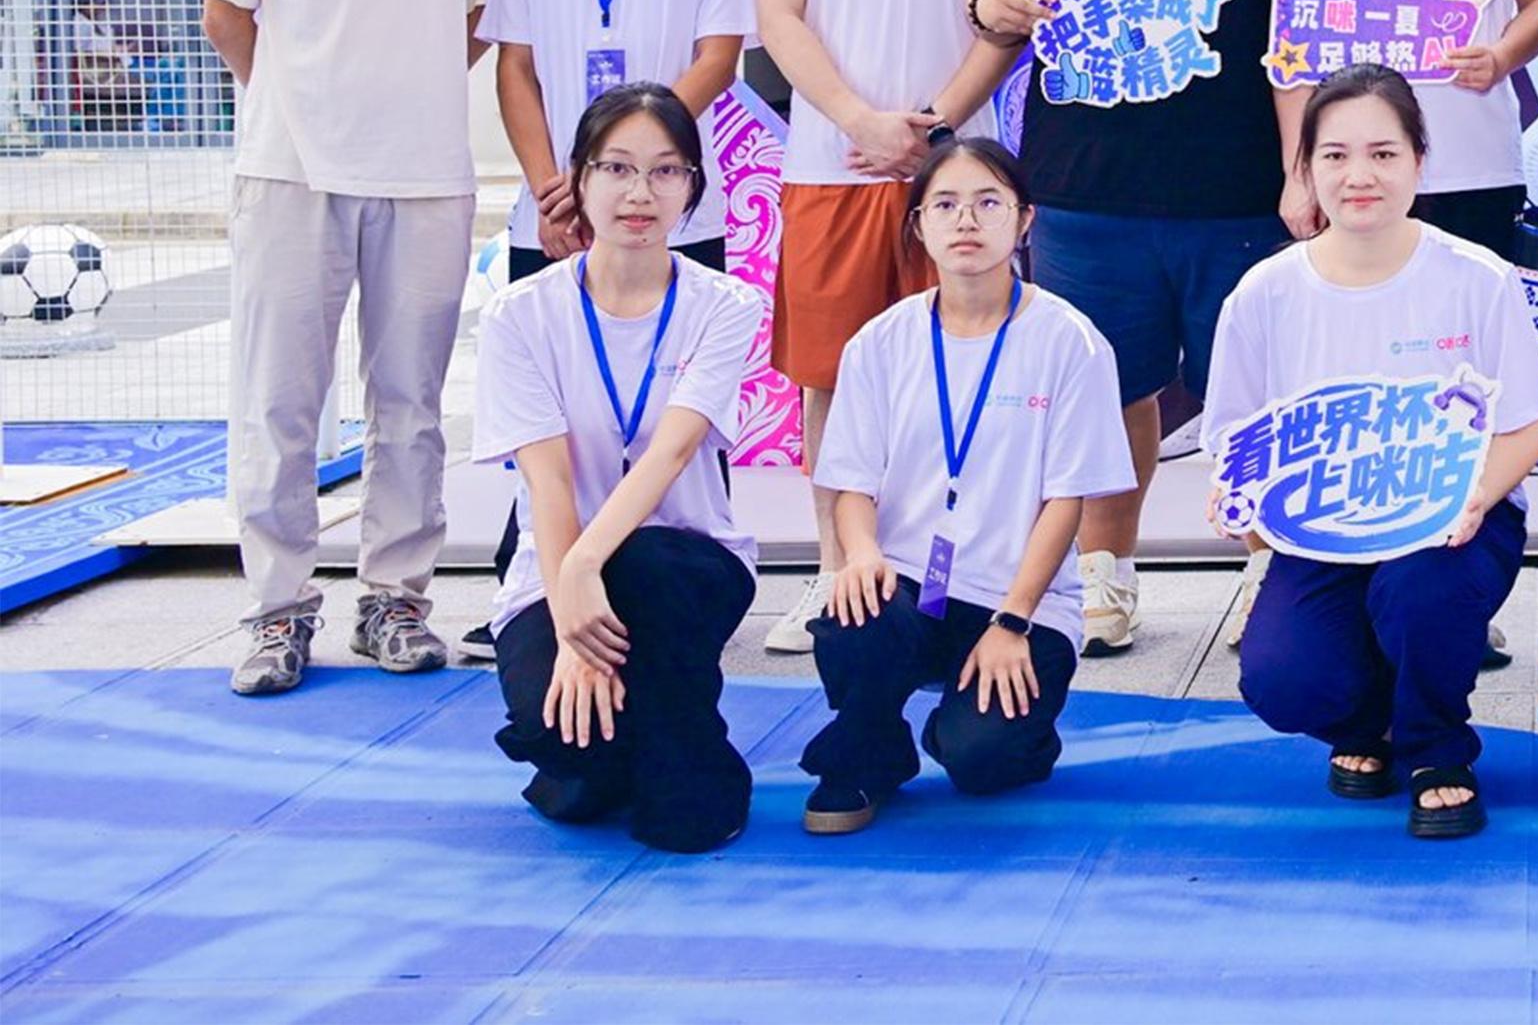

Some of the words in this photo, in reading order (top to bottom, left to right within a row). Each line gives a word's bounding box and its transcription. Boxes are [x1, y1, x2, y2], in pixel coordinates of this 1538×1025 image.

[1083, 26, 1217, 103] 蓝精灵
[1300, 432, 1482, 524] 上咪咕
